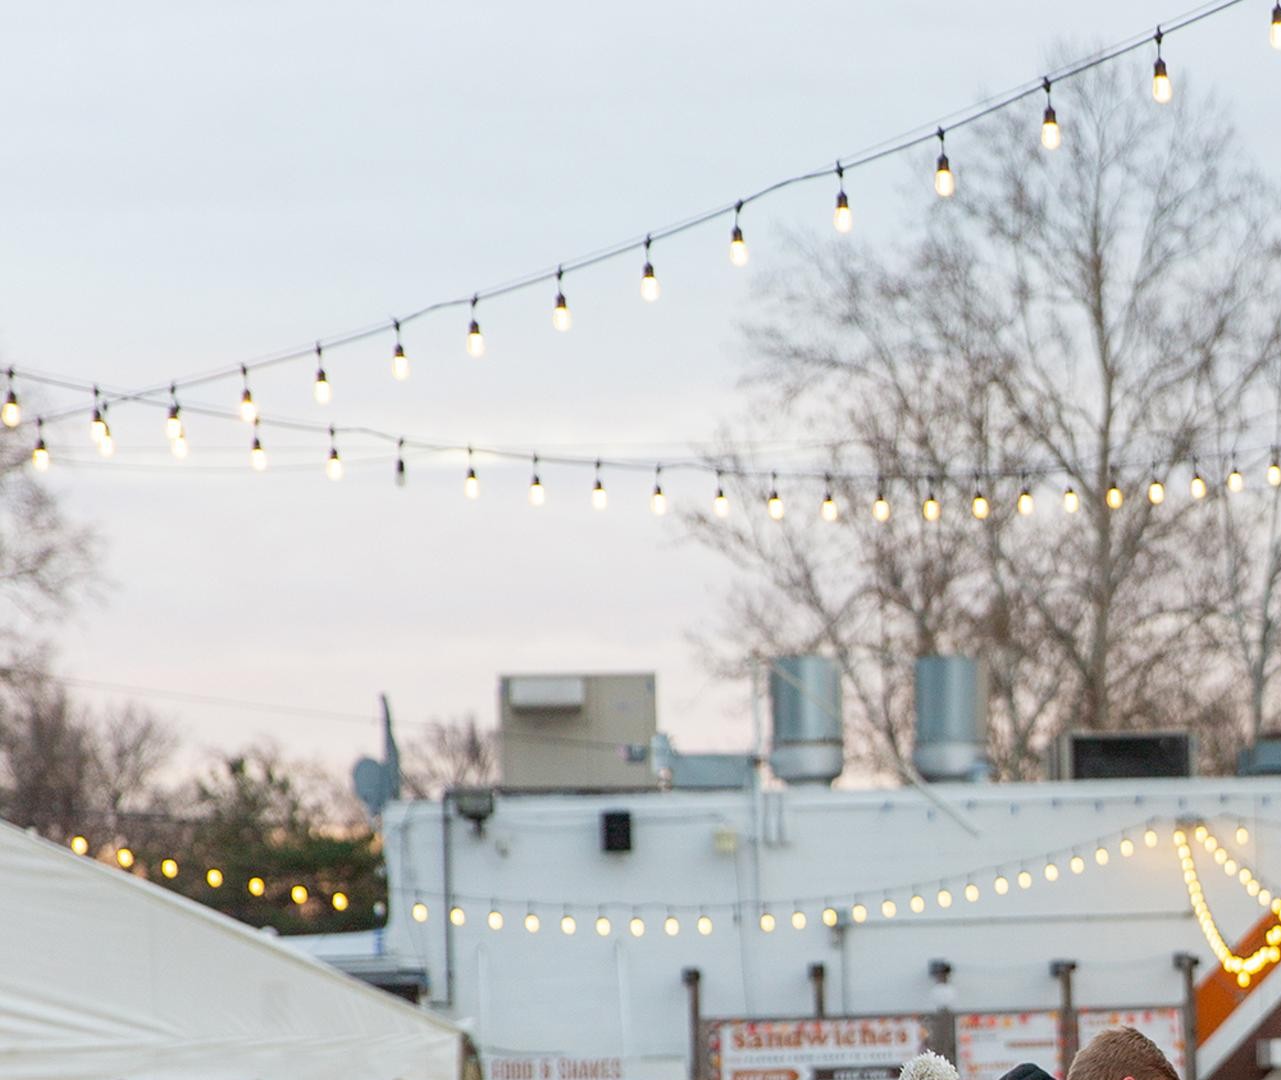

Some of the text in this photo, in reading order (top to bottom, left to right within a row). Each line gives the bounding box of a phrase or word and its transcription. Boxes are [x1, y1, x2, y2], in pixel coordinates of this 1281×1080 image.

[732, 1025, 907, 1048] Sandwiches
[492, 1058, 532, 1080] FOOD
[560, 1057, 621, 1079] SHAKES
